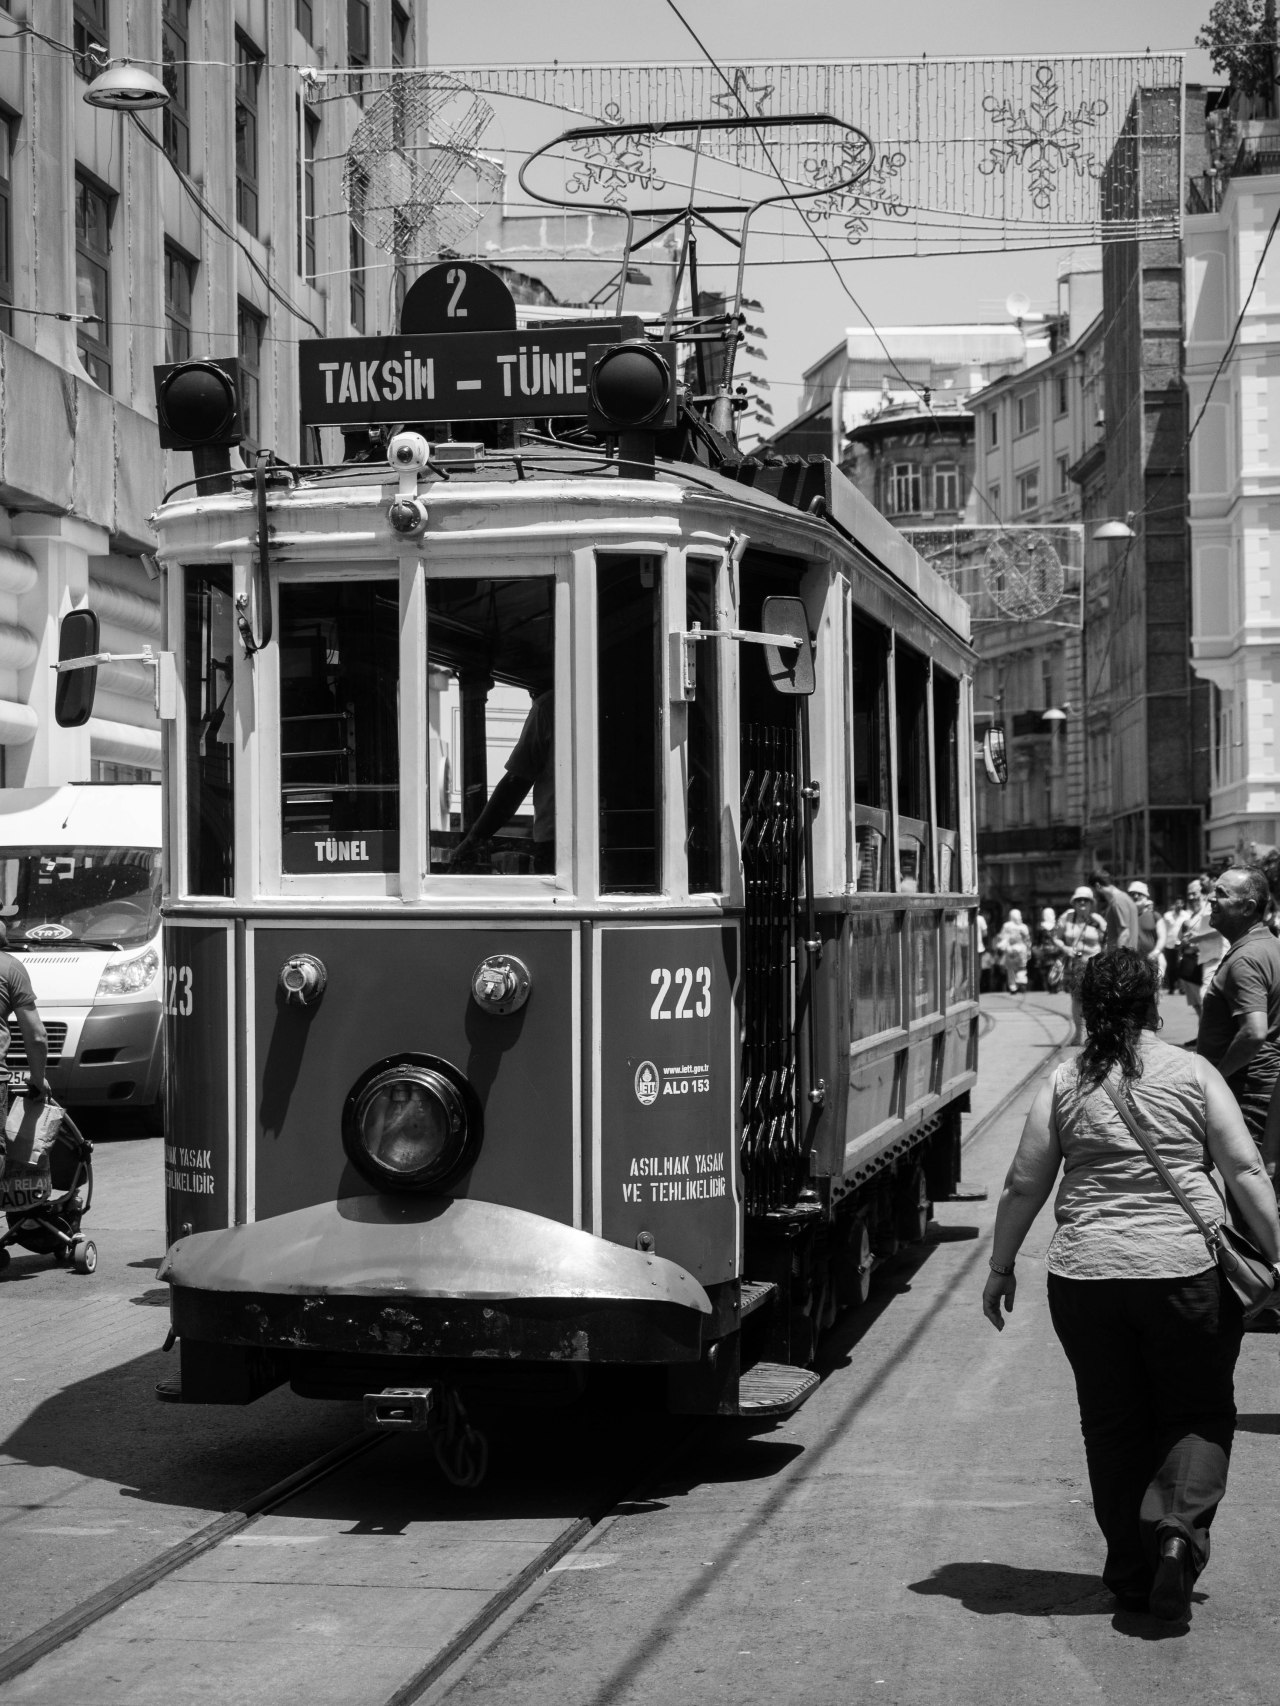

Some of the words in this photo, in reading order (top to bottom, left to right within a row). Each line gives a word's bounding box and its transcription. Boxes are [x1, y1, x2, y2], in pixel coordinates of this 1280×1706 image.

[446, 268, 468, 317] 2
[319, 351, 435, 403] TAKSİM
[497, 346, 587, 397] TÜNE
[314, 837, 369, 862] TÜNEL
[650, 966, 711, 1020] 223
[663, 1064, 710, 1075] www.iett.gov.tr
[663, 1081, 689, 1095] ALO
[692, 1079, 710, 1093] 153
[180, 1147, 212, 1169] YASAK
[629, 1156, 690, 1177] ASILMAK
[695, 1152, 724, 1174] YASAK
[622, 1183, 642, 1203] VE
[650, 1175, 726, 1202] TEHLİKELİDİR
